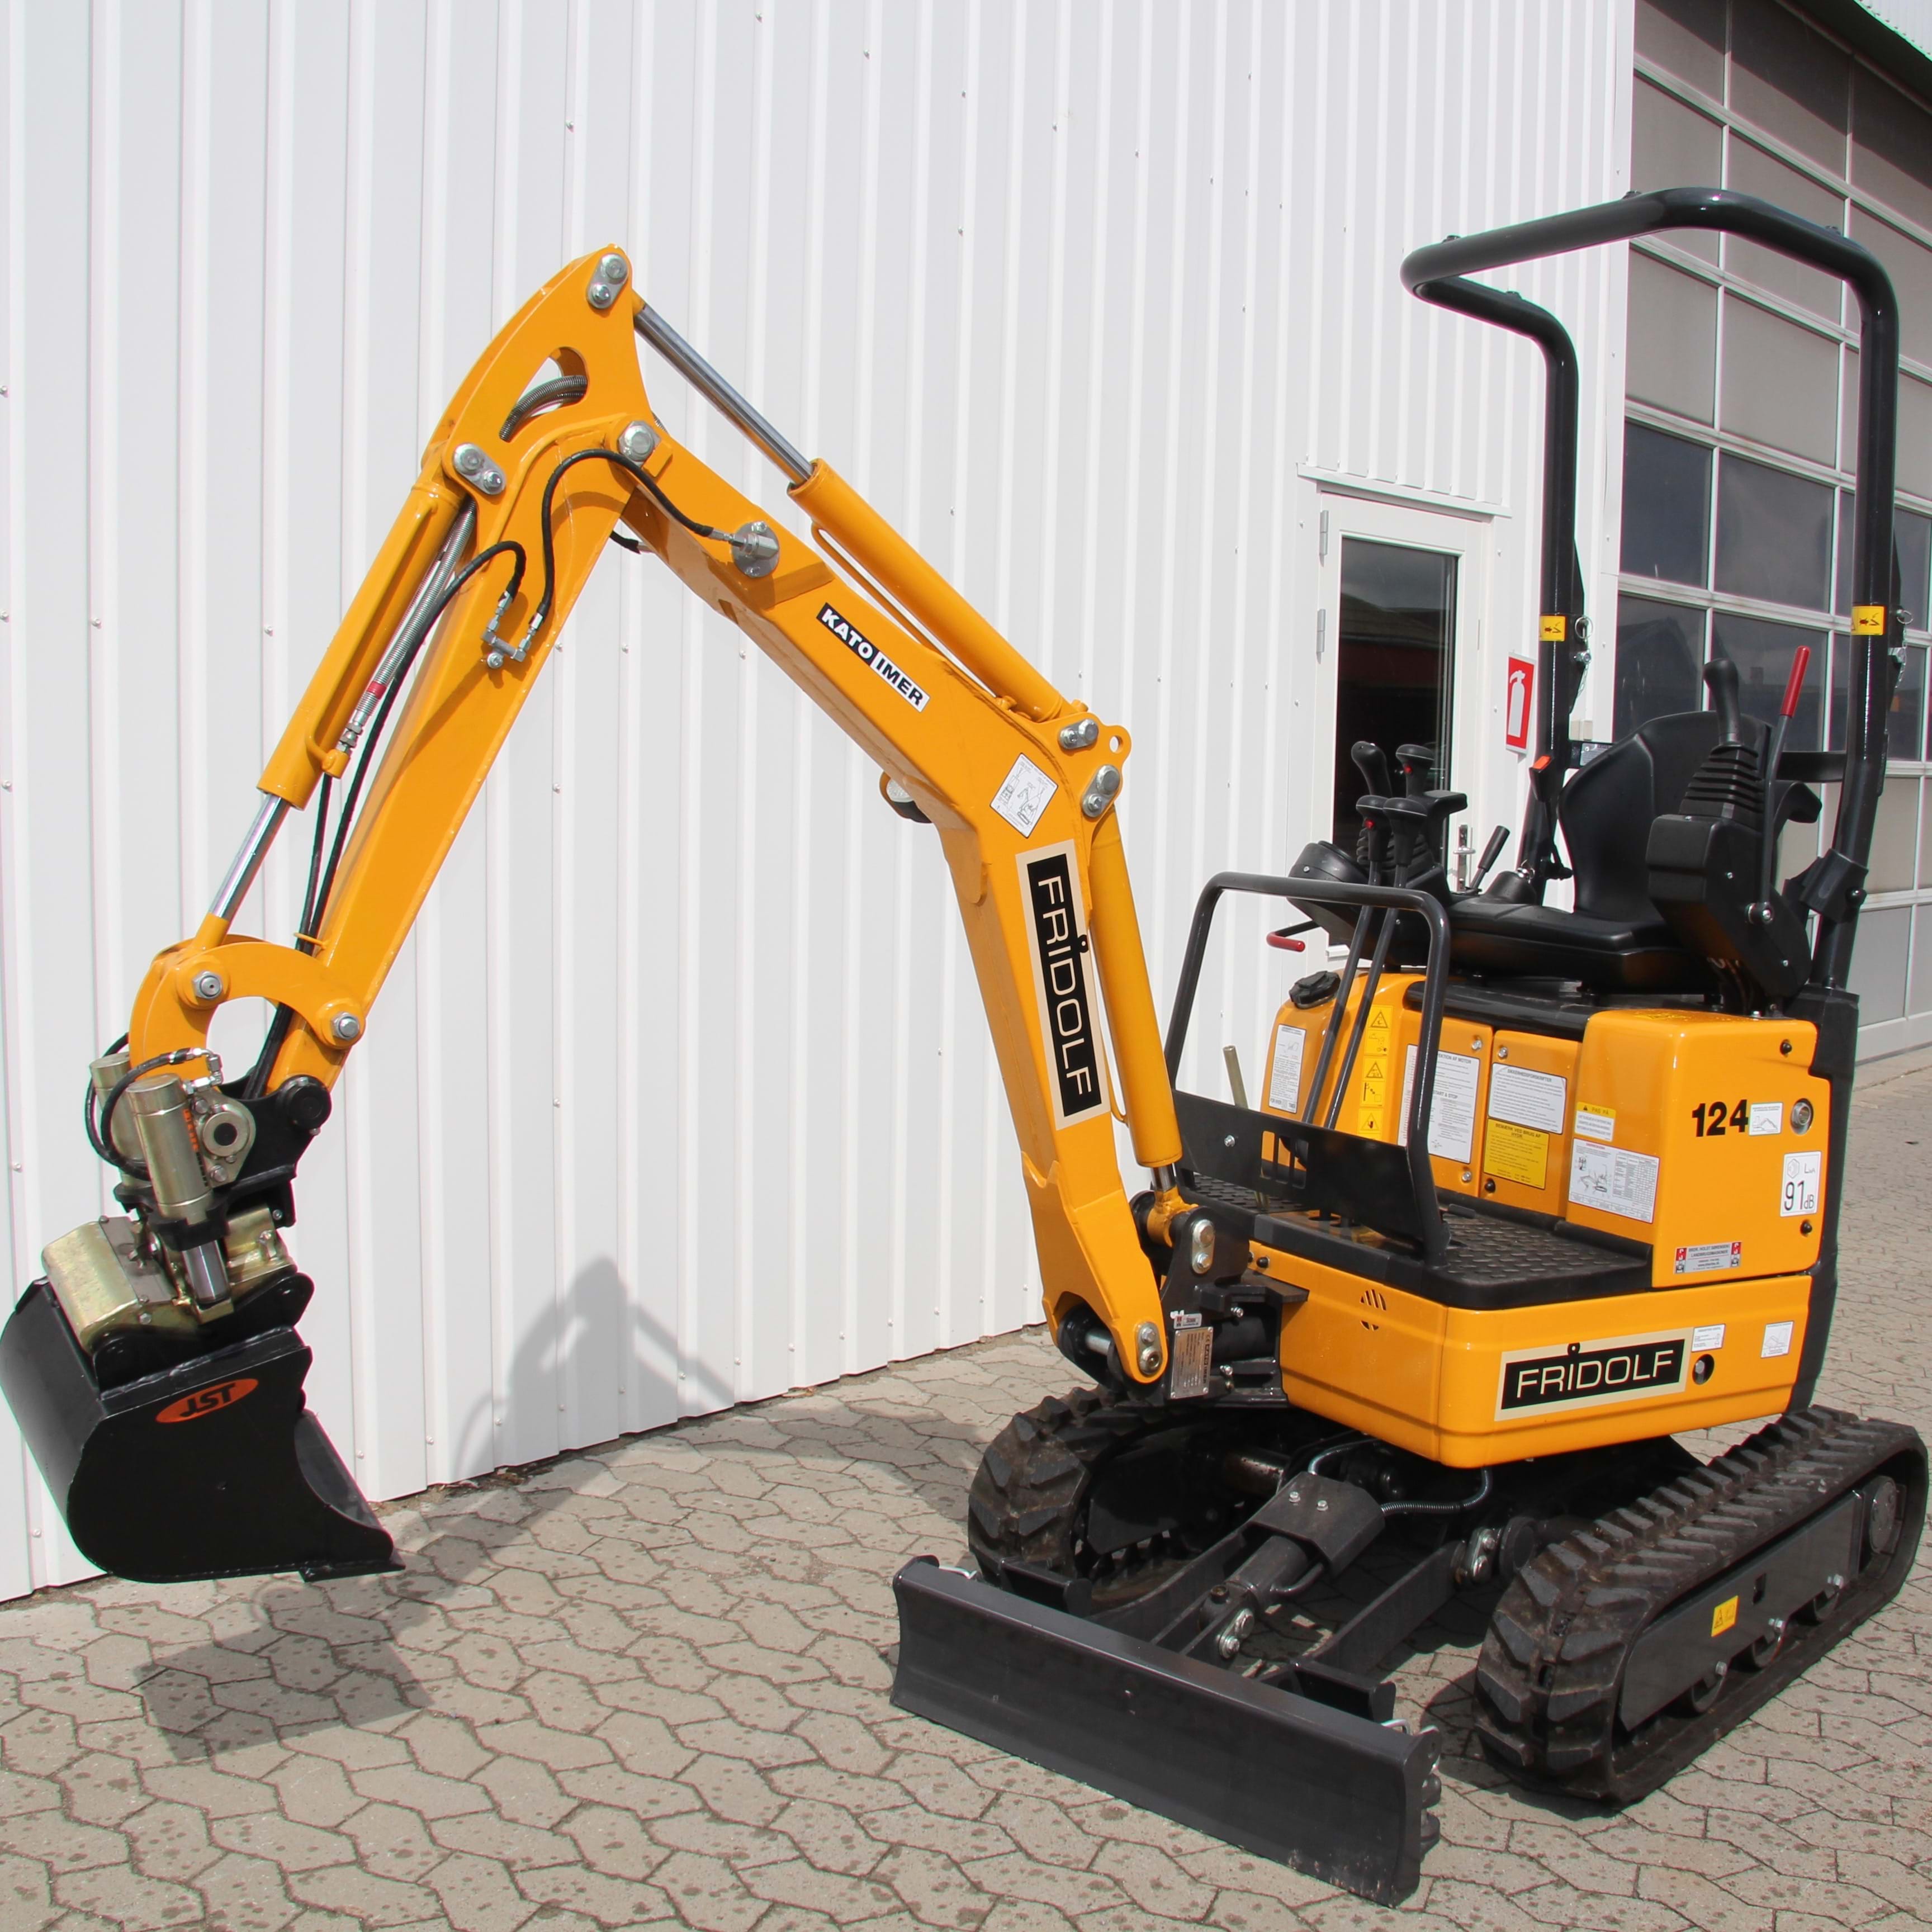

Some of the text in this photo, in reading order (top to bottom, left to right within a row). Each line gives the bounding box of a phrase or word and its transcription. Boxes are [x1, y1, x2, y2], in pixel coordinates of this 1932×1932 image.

[821, 608, 923, 706] KATO IMER
[1038, 875, 1091, 1095] FRIDOLF
[1692, 1099, 1749, 1137] 124
[1784, 1180, 1815, 1211] 91 dB
[1517, 1346, 1674, 1398] FRIDOLF
[179, 1382, 236, 1417] JST
